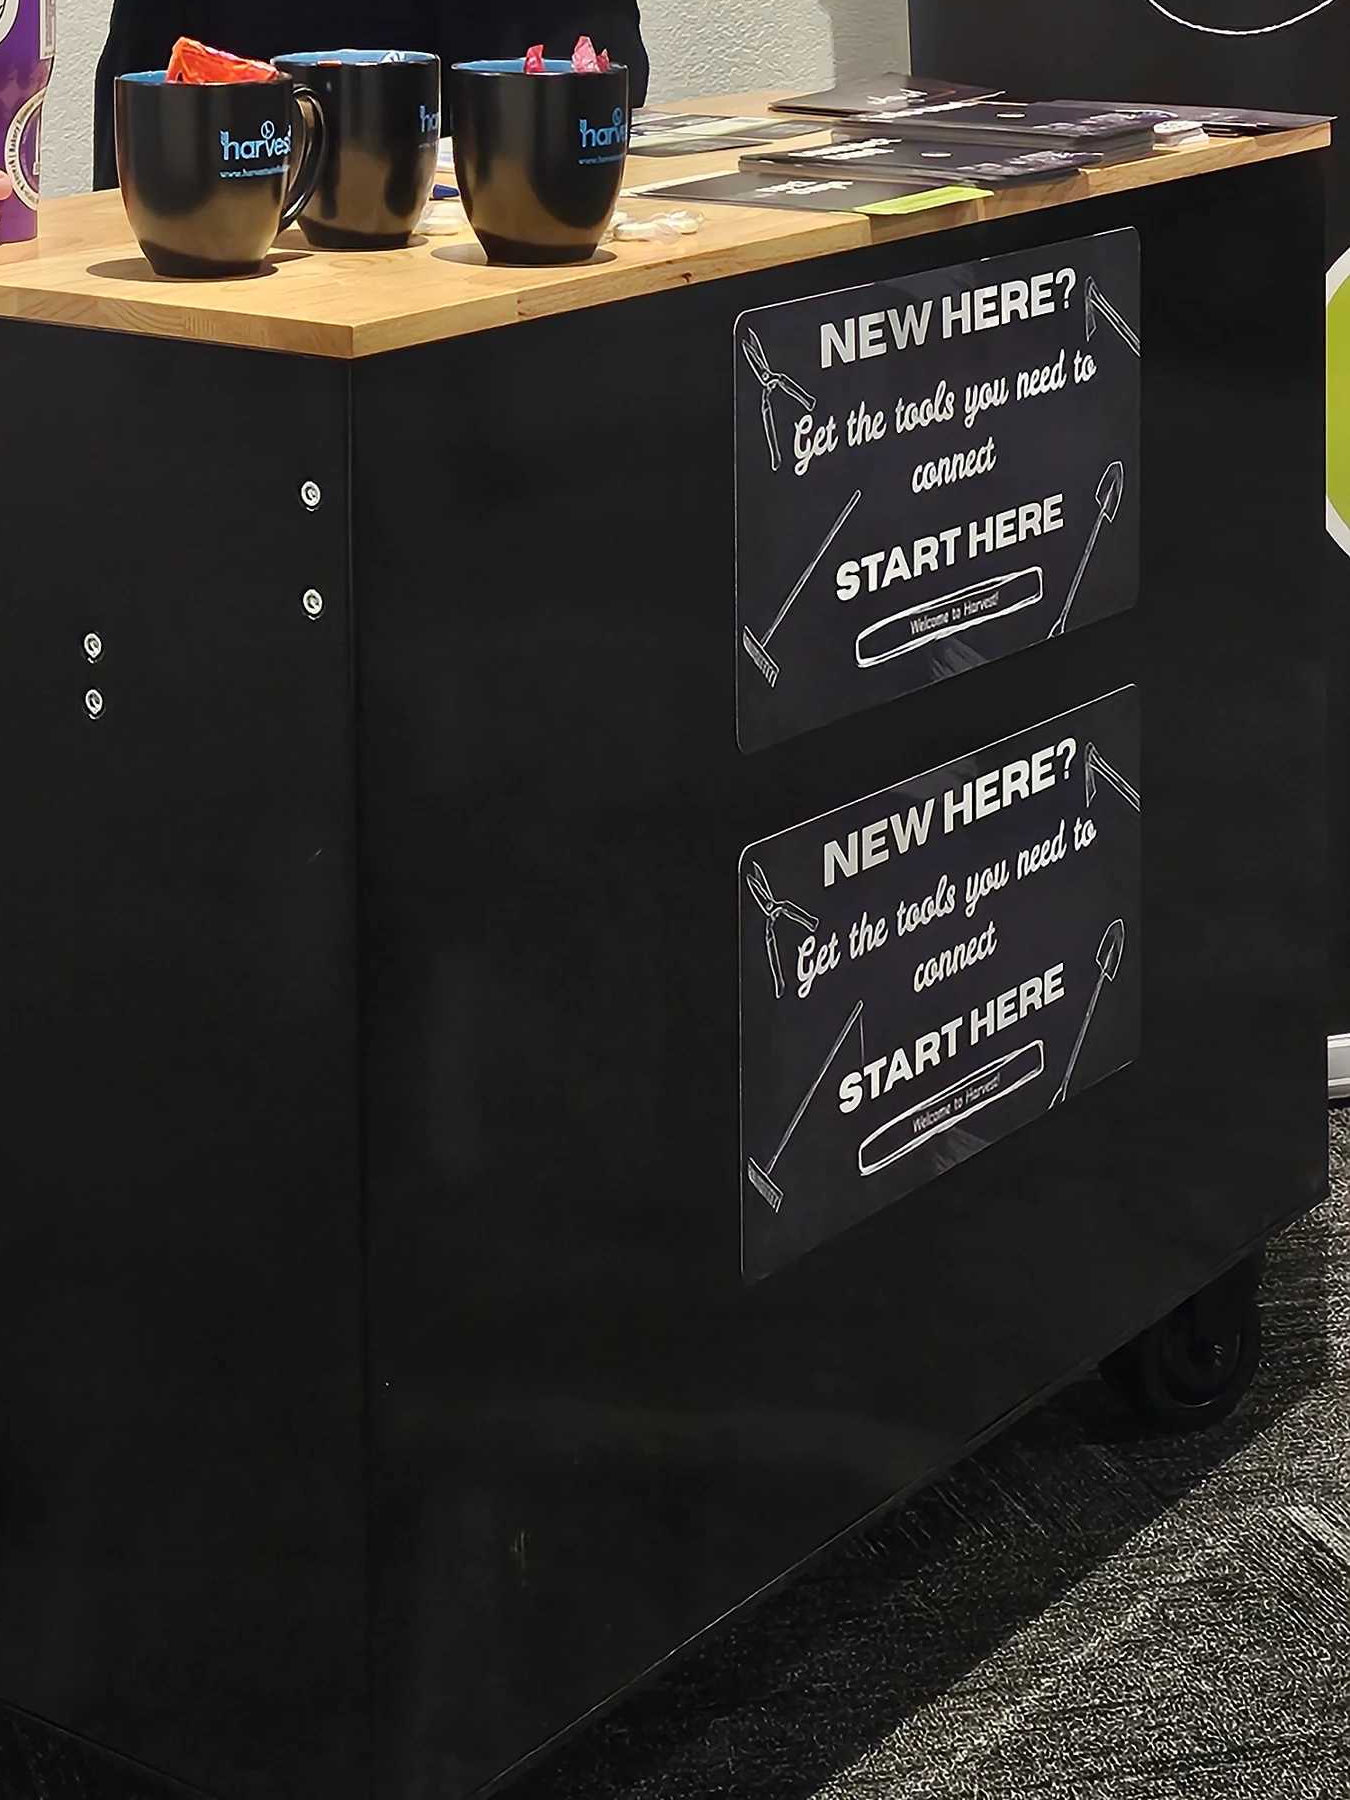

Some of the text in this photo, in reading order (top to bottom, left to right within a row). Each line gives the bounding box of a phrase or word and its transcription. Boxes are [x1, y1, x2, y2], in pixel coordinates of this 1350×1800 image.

[820, 268, 1076, 368] NEW HERE?
[793, 349, 1097, 476] Get the tools you need to
[911, 436, 996, 494] connect
[835, 494, 1064, 601] START HERE
[910, 611, 949, 634] Welcome
[952, 607, 961, 620] to
[823, 737, 1077, 887] NEW HERE?
[796, 817, 1097, 999] Get the tools you need to
[913, 920, 998, 993] connect
[838, 962, 1066, 1114] START HERE
[912, 1103, 951, 1133] Welcome
[953, 1096, 963, 1111] to
